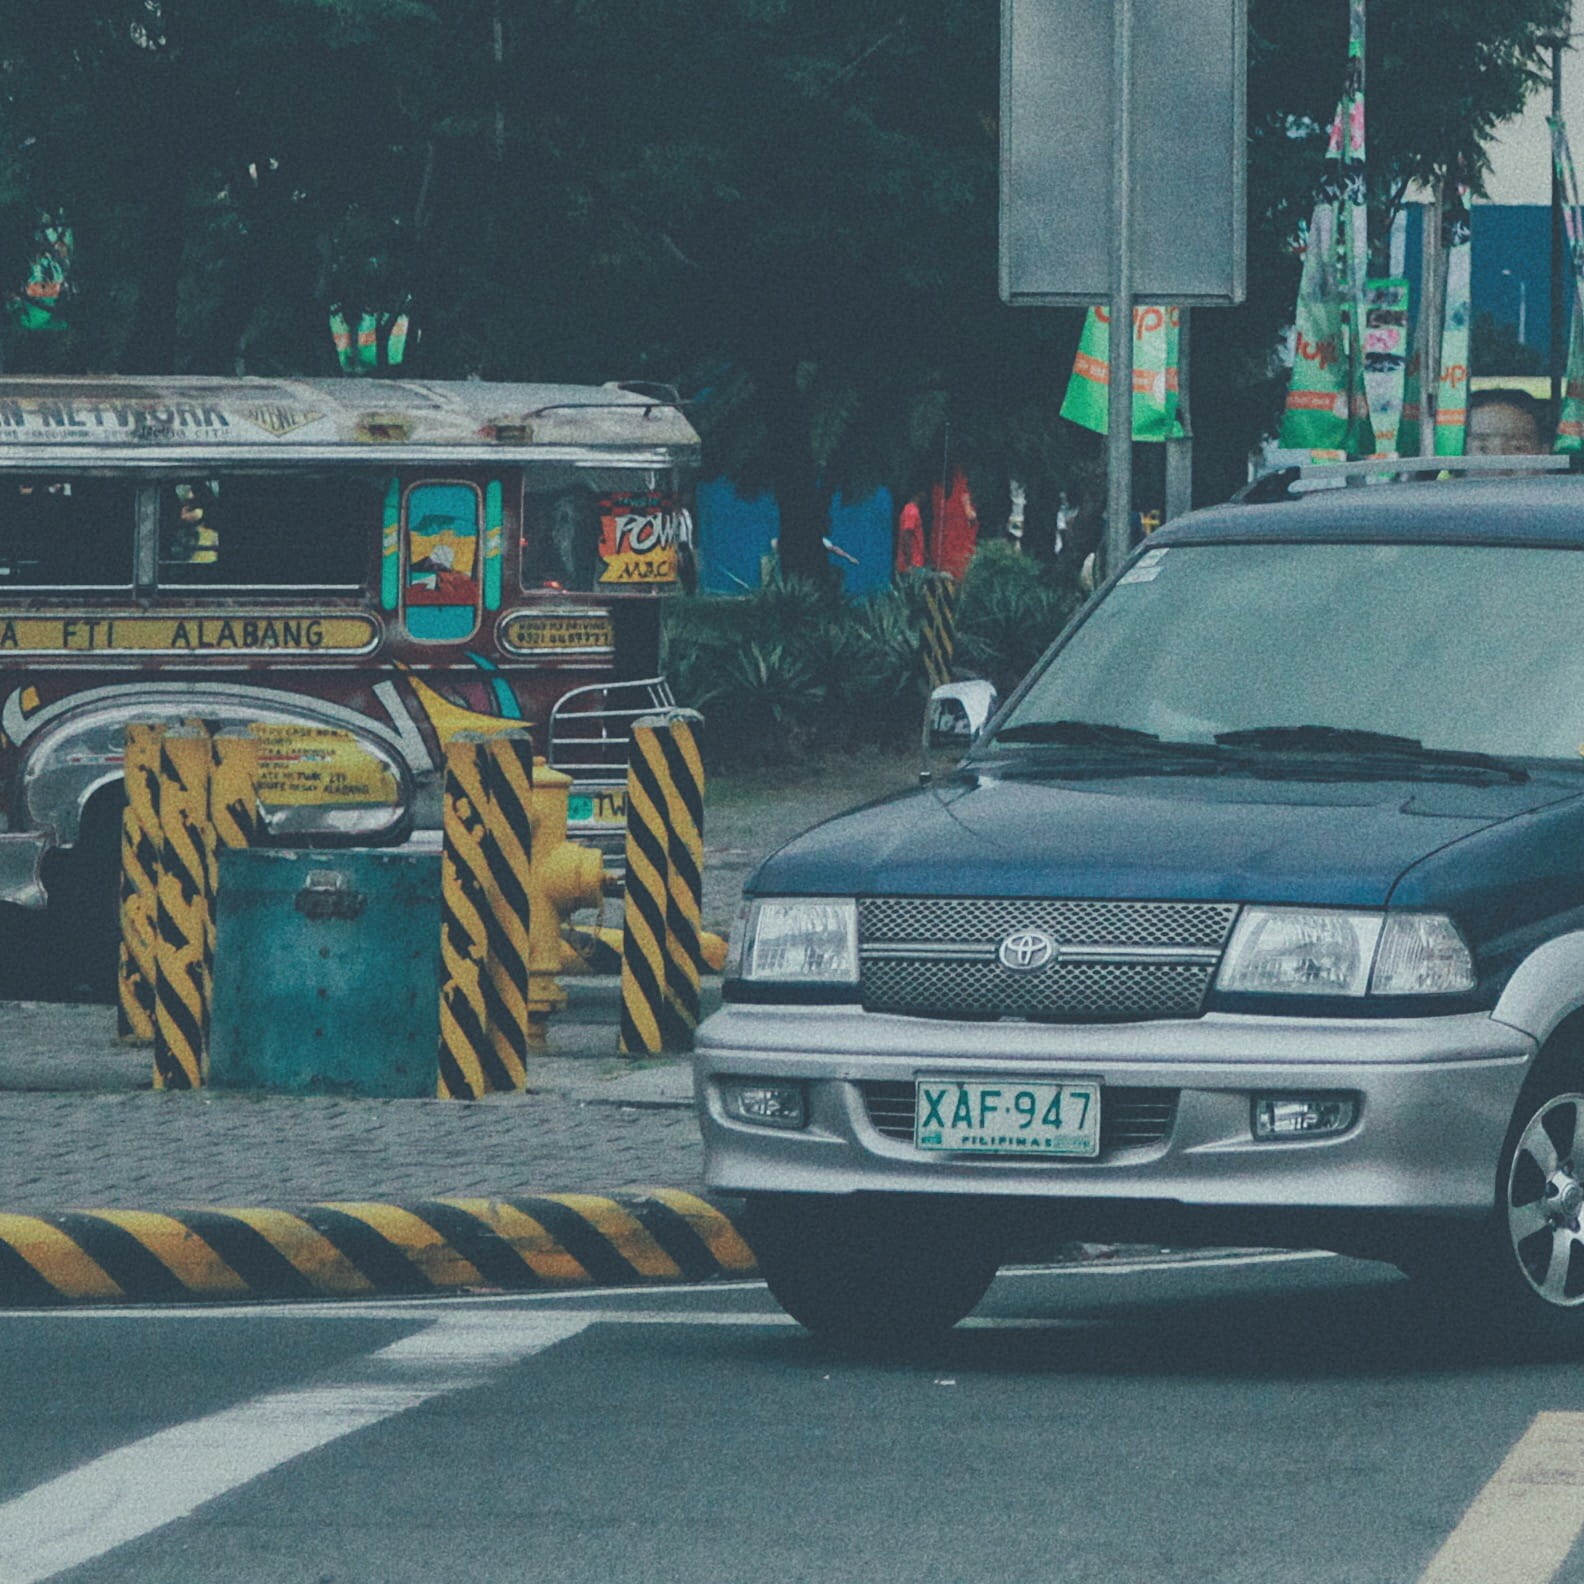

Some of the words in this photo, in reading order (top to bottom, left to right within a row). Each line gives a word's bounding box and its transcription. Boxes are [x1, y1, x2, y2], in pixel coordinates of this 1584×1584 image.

[63, 621, 114, 648] FTI
[171, 620, 323, 649] ALABANG
[961, 1136, 1053, 1148] PILIPINAS
